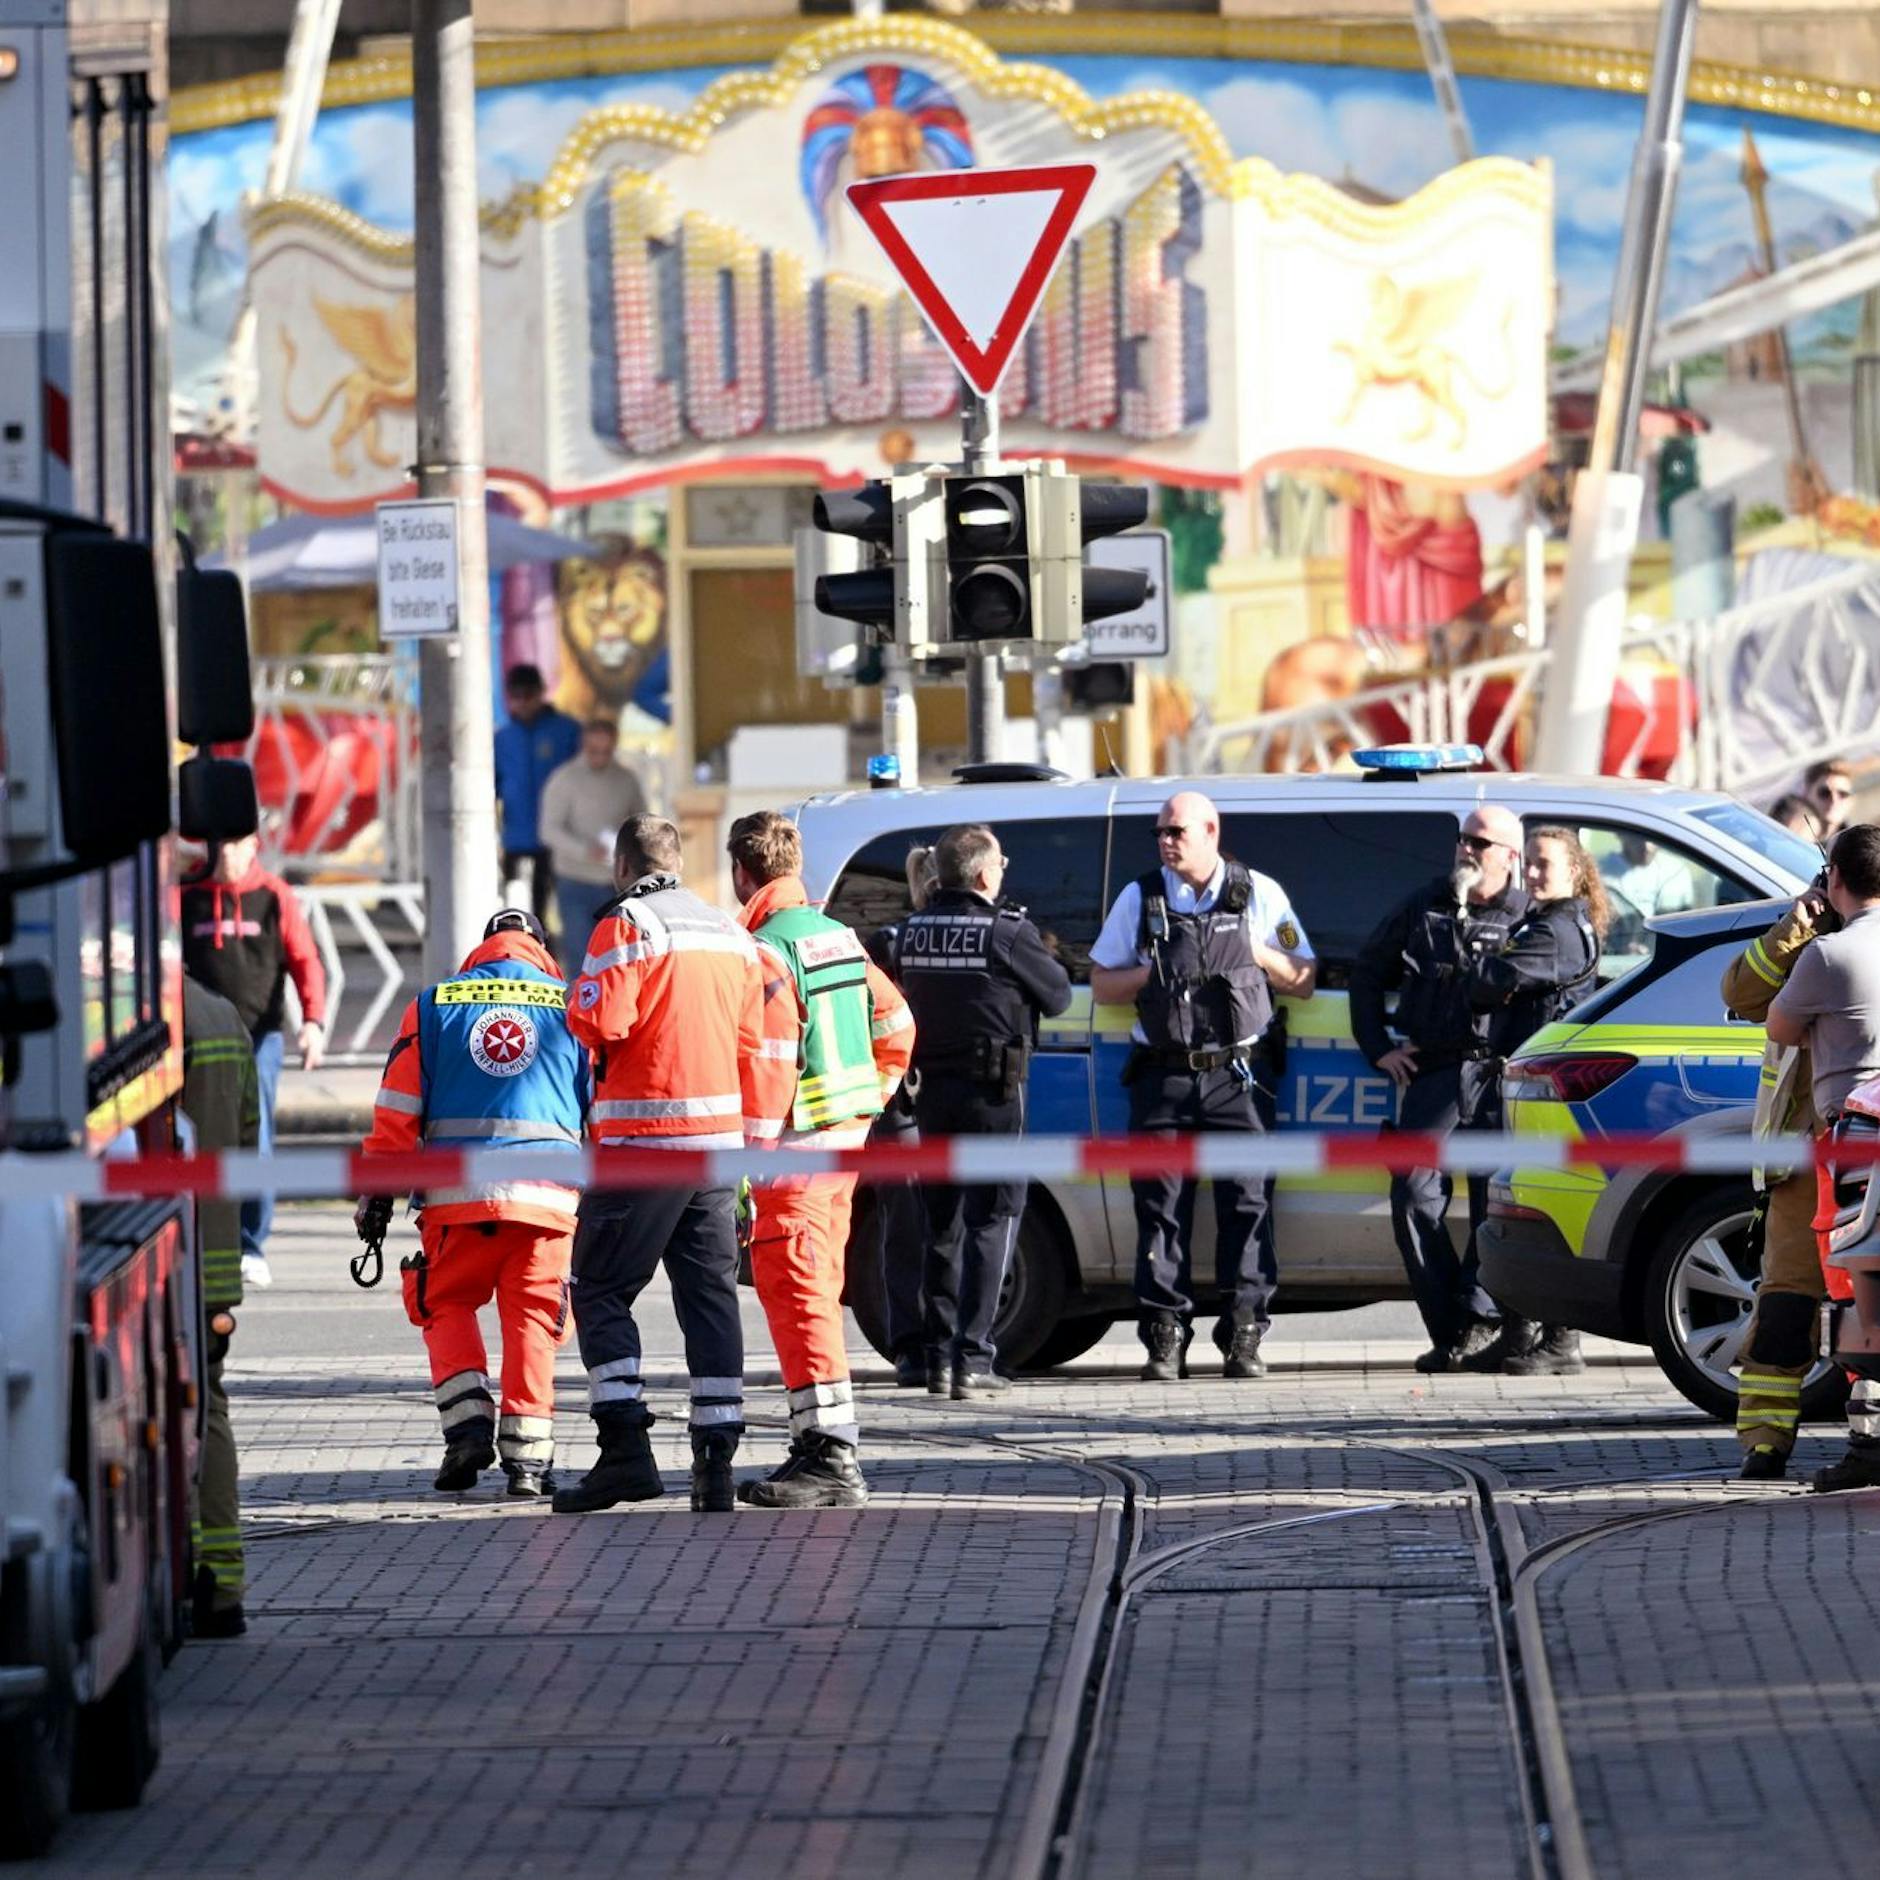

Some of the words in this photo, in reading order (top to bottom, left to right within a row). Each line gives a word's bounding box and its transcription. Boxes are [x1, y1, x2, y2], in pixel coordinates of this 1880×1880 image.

[590, 162, 1208, 456] COLOSUS
[1082, 623, 1157, 643] orrang
[903, 927, 986, 953] POLIZEI
[472, 993, 501, 1001] EE
[477, 1012, 532, 1035] JOHANNITER
